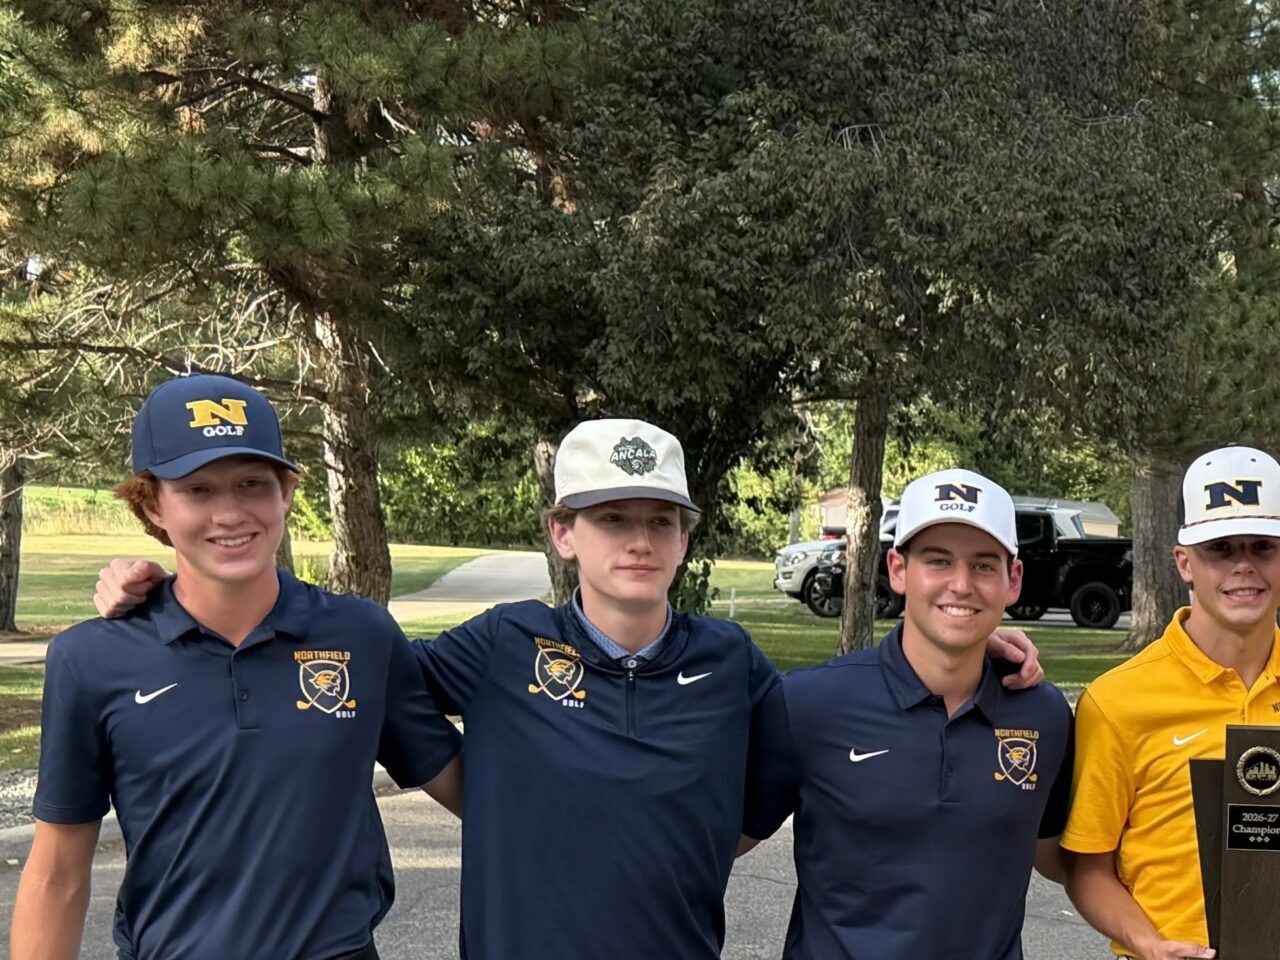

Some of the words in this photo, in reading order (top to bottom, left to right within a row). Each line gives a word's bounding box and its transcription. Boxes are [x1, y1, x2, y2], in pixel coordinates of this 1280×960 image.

[186, 398, 248, 427] N
[203, 425, 245, 437] GOLF
[610, 449, 656, 462] ANCALA
[934, 483, 982, 504] N
[1203, 478, 1263, 511] N
[939, 503, 975, 513] GOLF
[294, 650, 351, 660] NORTHFIELD
[562, 699, 585, 708] GOLF
[335, 710, 356, 718] GOLF
[994, 728, 1039, 739] NORTHFIELD
[1242, 812, 1279, 823] 2026-27
